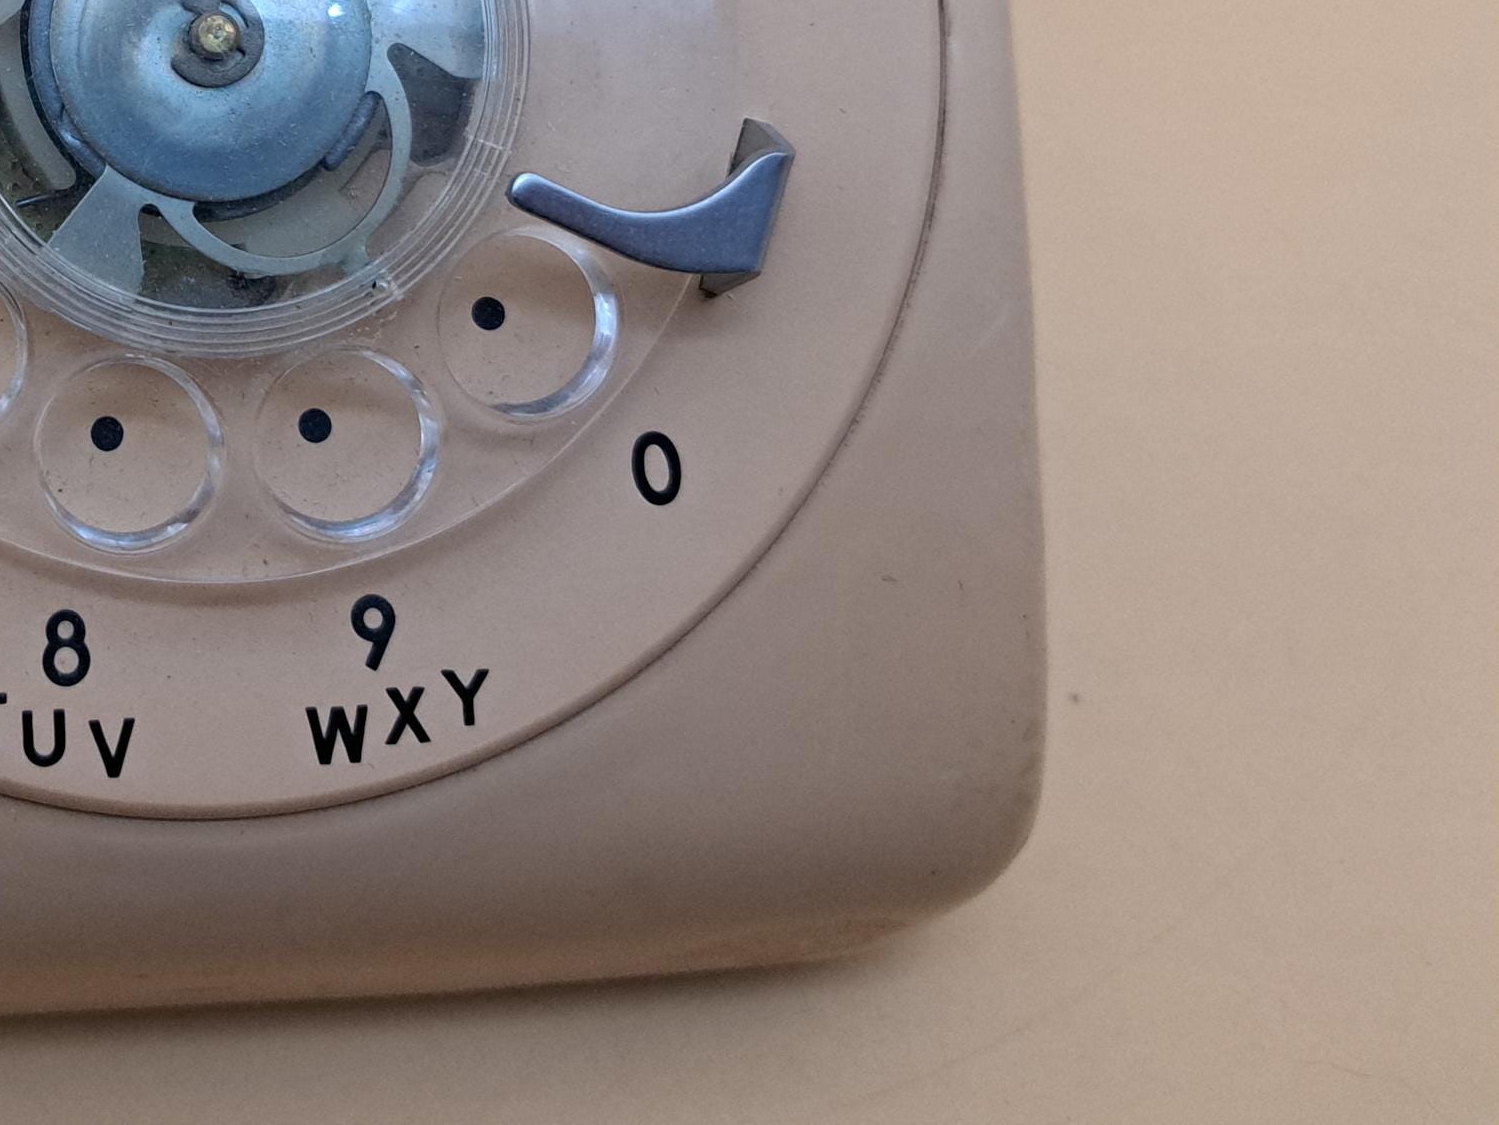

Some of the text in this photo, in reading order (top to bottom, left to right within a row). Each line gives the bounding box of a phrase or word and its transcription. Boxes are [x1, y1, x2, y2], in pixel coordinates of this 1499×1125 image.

[631, 430, 683, 507] 0
[41, 608, 92, 688] 8
[350, 593, 397, 672] 9
